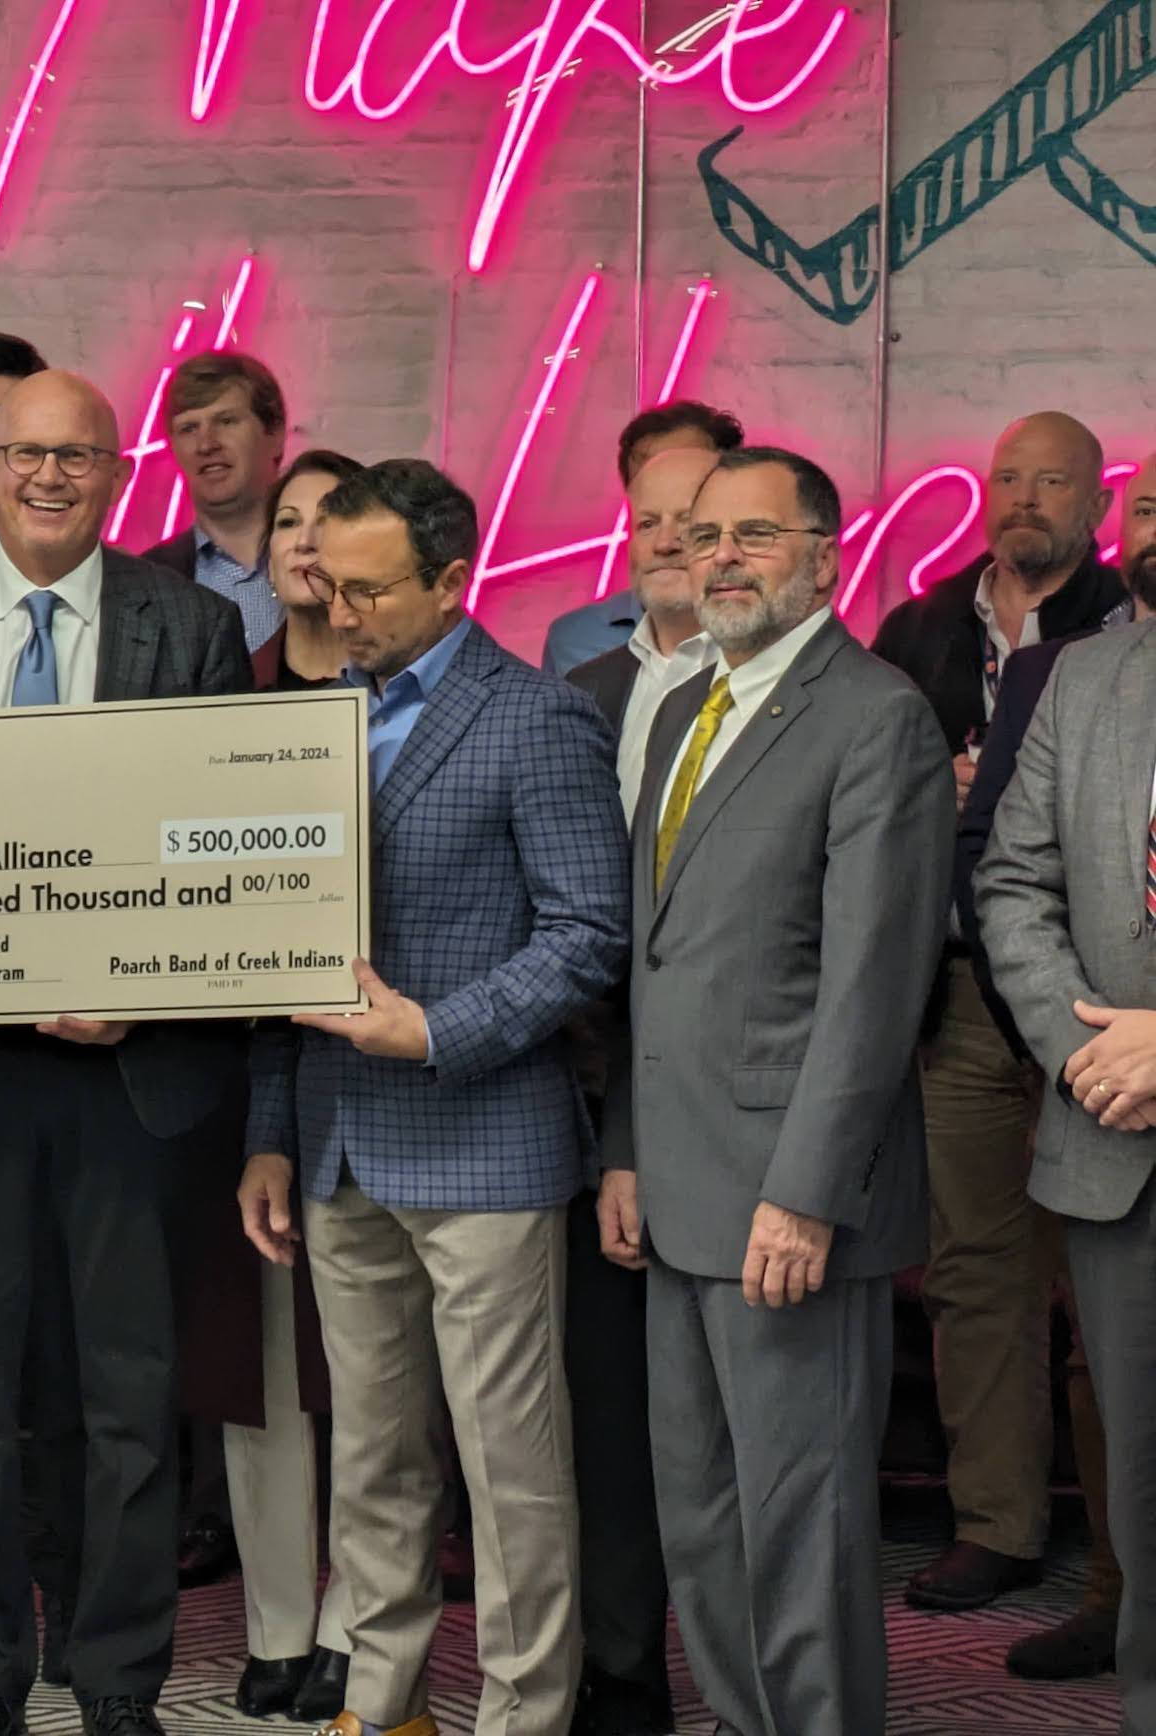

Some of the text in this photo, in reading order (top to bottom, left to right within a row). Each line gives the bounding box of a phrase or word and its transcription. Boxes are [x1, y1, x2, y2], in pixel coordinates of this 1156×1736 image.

[228, 751, 274, 764] January
[278, 749, 296, 761] 24,
[300, 747, 330, 760] 2024
[166, 825, 327, 856] $ 500,000.00
[31, 877, 167, 912] Thousand
[177, 874, 232, 905] and
[242, 872, 311, 893] 00/100
[109, 949, 345, 975] Poarch Band of Creek Indians
